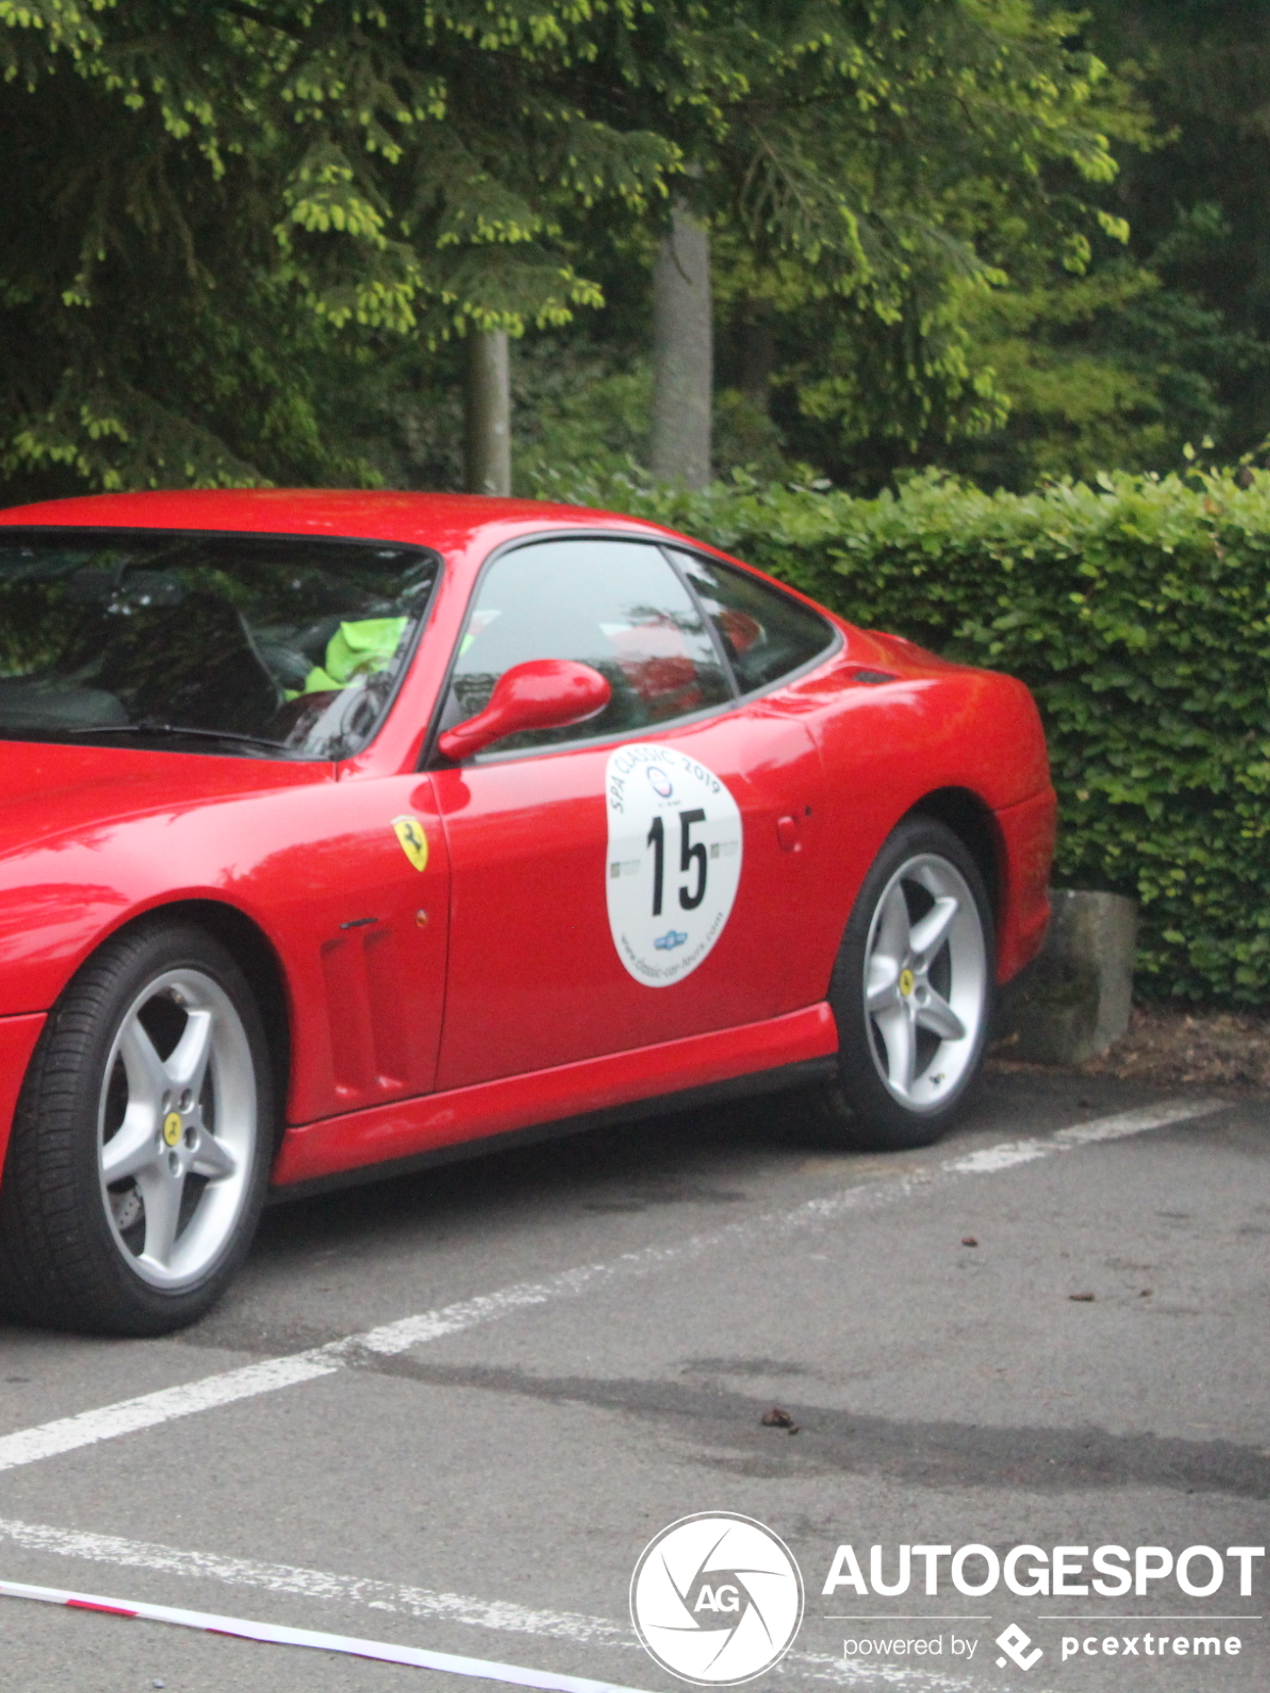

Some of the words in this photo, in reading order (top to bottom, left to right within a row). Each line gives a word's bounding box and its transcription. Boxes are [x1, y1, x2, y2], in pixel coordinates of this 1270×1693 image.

[614, 746, 676, 775] CLASSIC
[680, 756, 721, 794] 2019
[609, 775, 625, 814] SPA
[646, 808, 707, 917] 15
